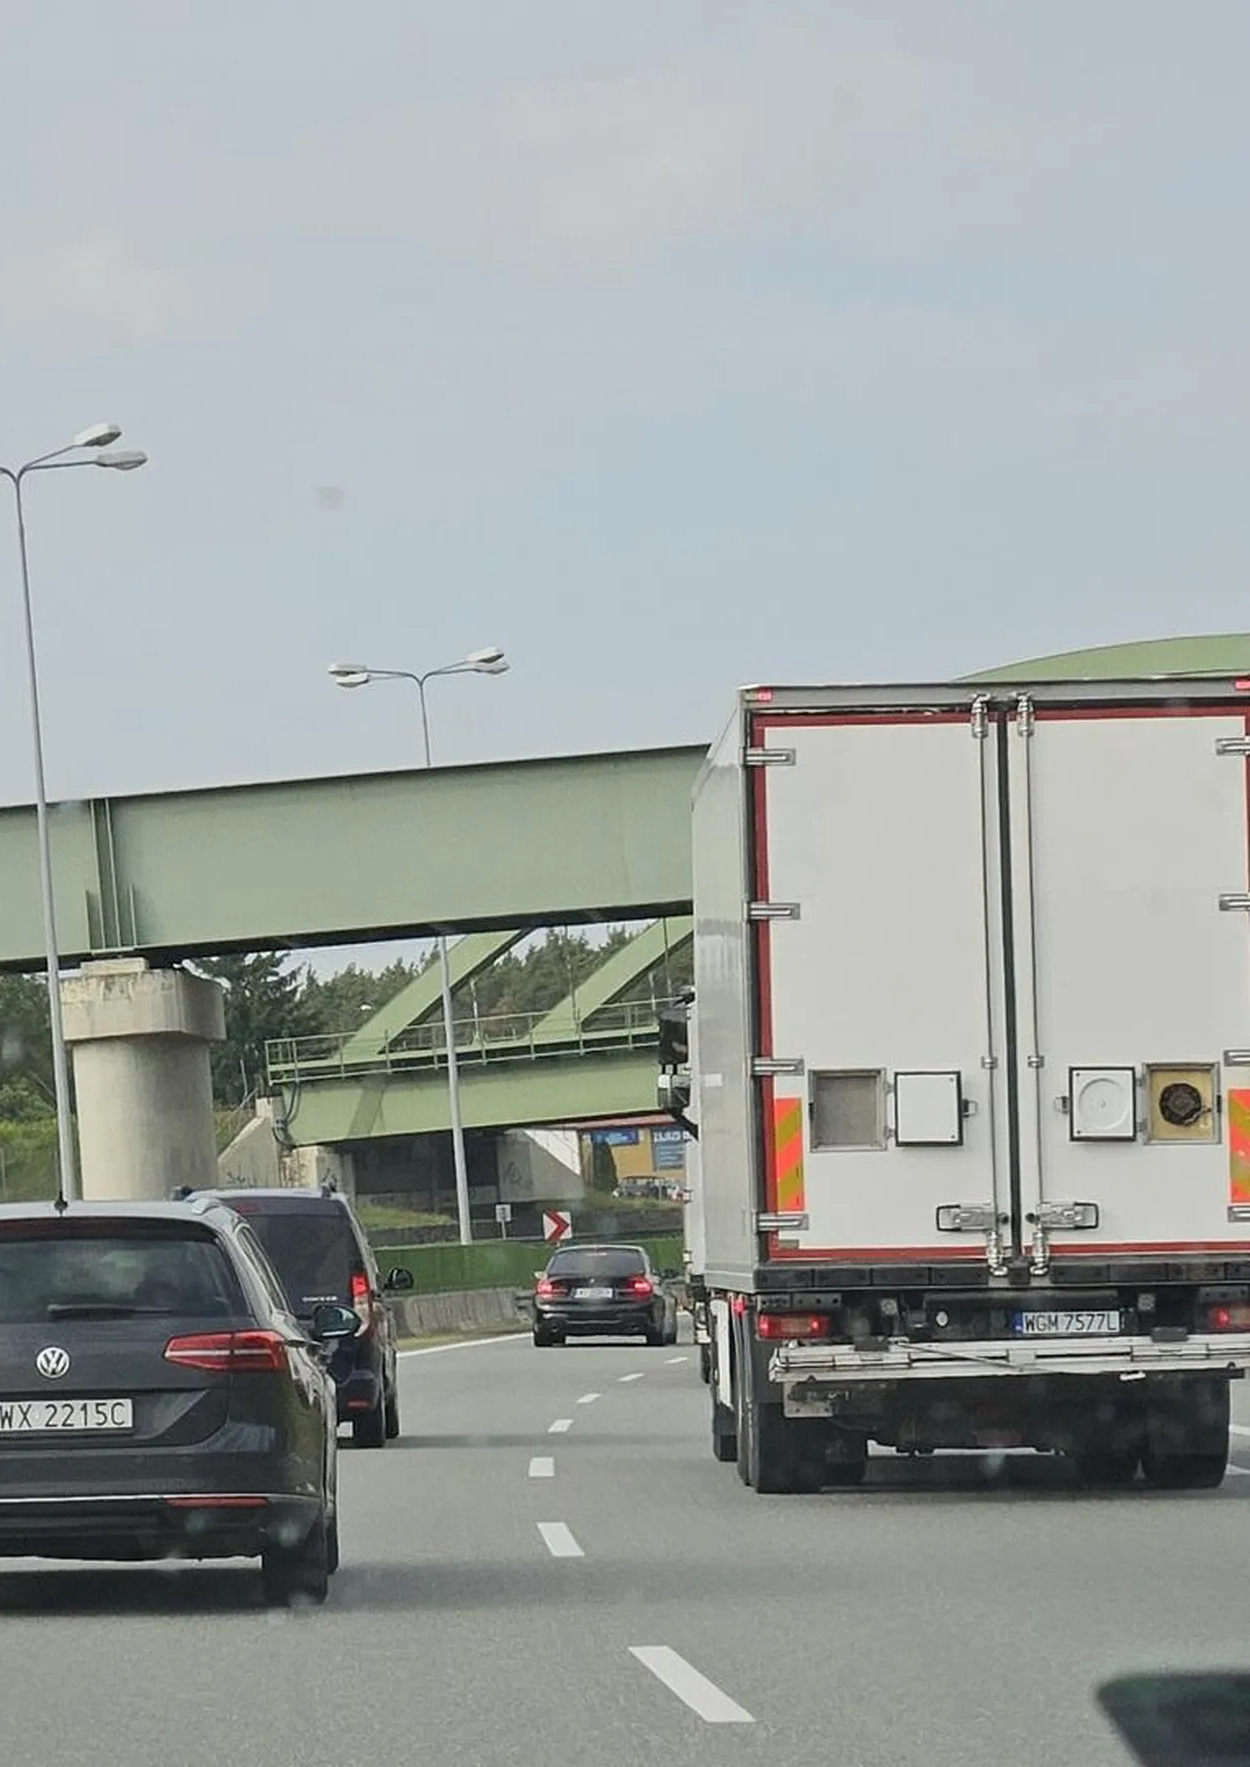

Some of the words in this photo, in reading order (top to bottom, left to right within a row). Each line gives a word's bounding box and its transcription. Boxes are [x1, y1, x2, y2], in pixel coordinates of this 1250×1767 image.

[1024, 1313, 1058, 1332] WGM
[1064, 1313, 1117, 1331] 7577L
[44, 1402, 126, 1428] 2215C
